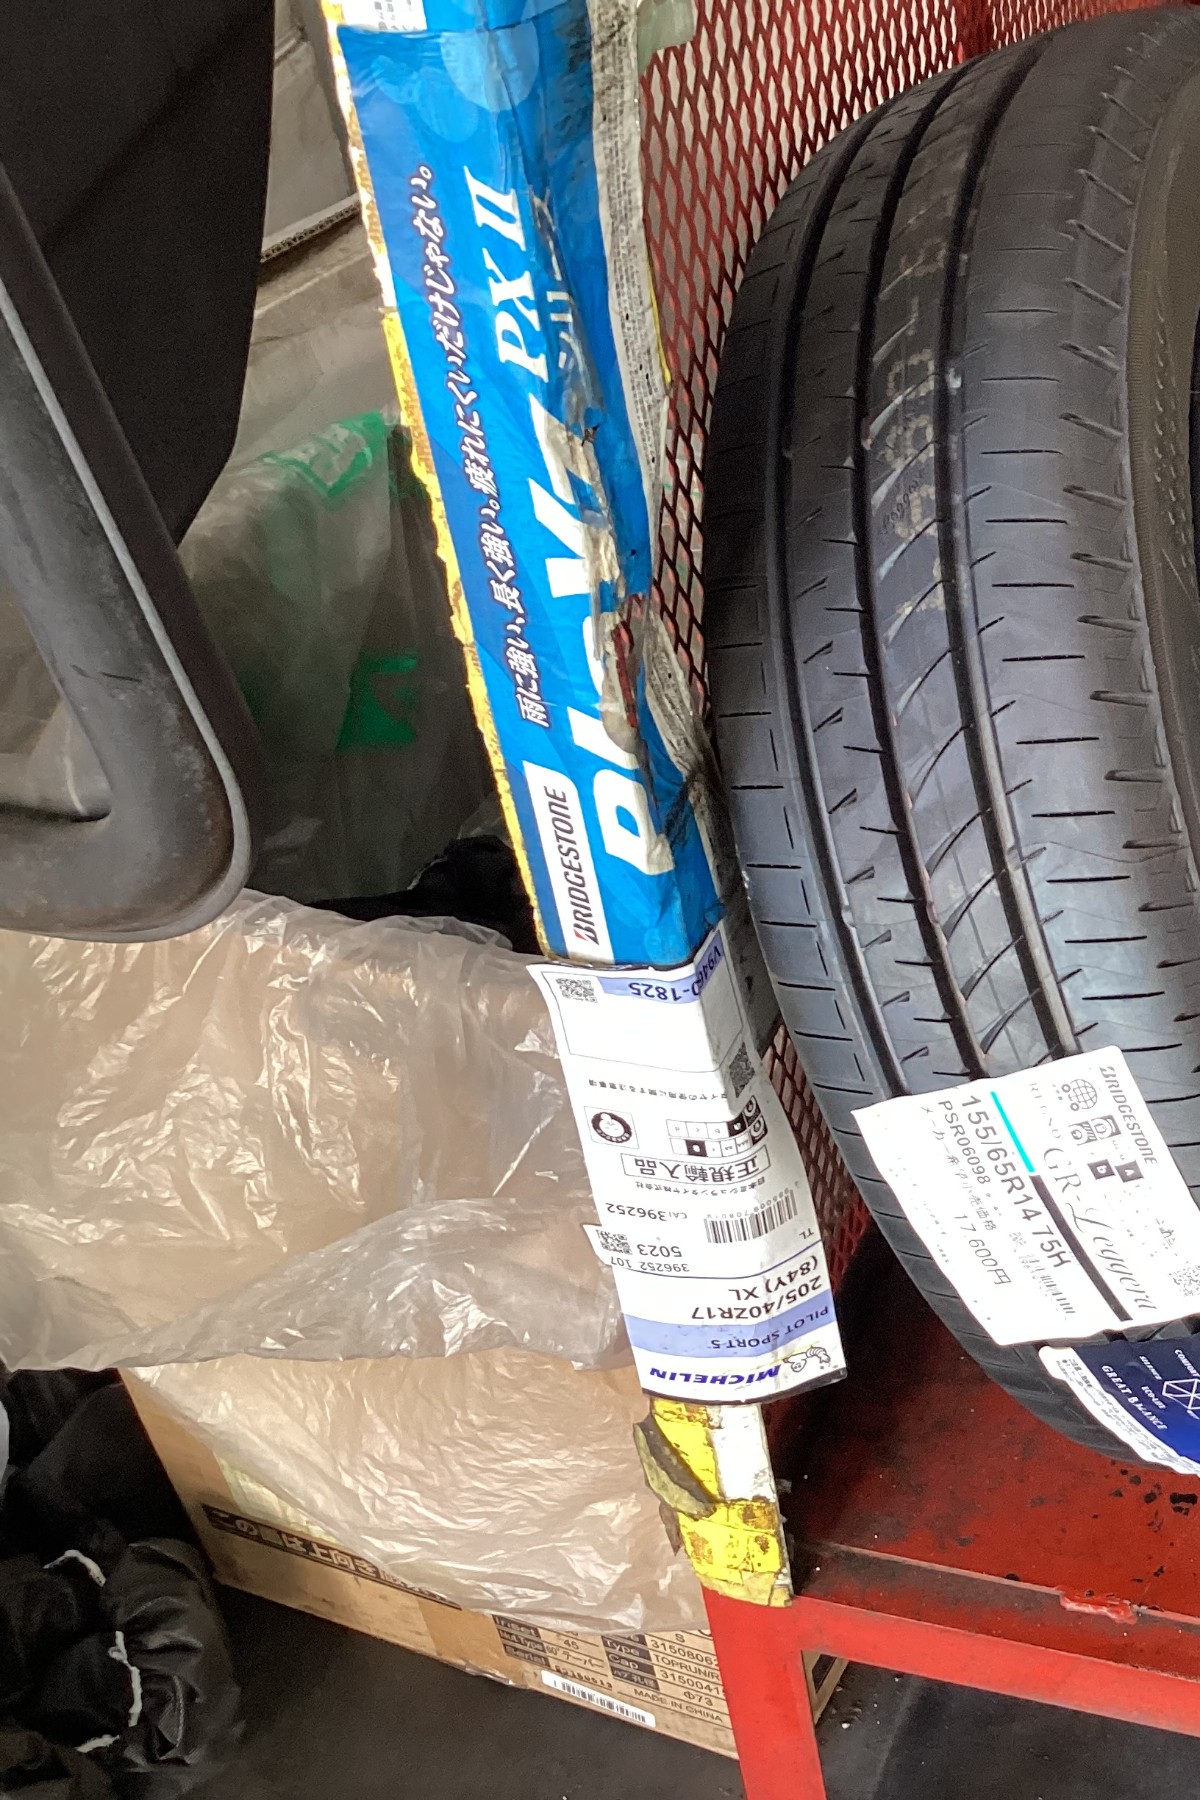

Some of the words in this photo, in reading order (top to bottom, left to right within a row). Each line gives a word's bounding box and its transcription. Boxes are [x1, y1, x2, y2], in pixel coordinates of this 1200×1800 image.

[543, 785, 600, 947] BRIDGESTONE
[1099, 1065, 1159, 1166] BRIDGESTONE
[937, 1100, 991, 1185] PSR06098
[634, 1155, 760, 1183] 正規輸入品
[961, 1095, 1042, 1222] 155/65R14
[1031, 1224, 1072, 1268] 75H
[636, 1176, 765, 1197] 日本ミシュランタイヤ株式会社
[799, 1227, 815, 1240] TL
[610, 1256, 632, 1269] 107
[636, 1243, 683, 1258] 5023
[640, 1261, 690, 1272] 396252
[765, 1255, 819, 1294] (84Y)
[691, 1275, 822, 1320] 205/40ZR17
[728, 1287, 760, 1301] XL
[784, 1305, 829, 1336] PILOT
[725, 1330, 780, 1350] SPORT
[649, 1364, 781, 1386] MICHELIN
[1101, 1365, 1132, 1395] GREAT
[563, 1639, 579, 1650] 45
[606, 1640, 640, 1656] Type
[608, 1653, 639, 1670] Cap
[659, 1669, 725, 1697] 3150041
[634, 1688, 668, 1705] MADE
[671, 1701, 683, 1710] IN
[685, 1705, 724, 1723] CHINA
